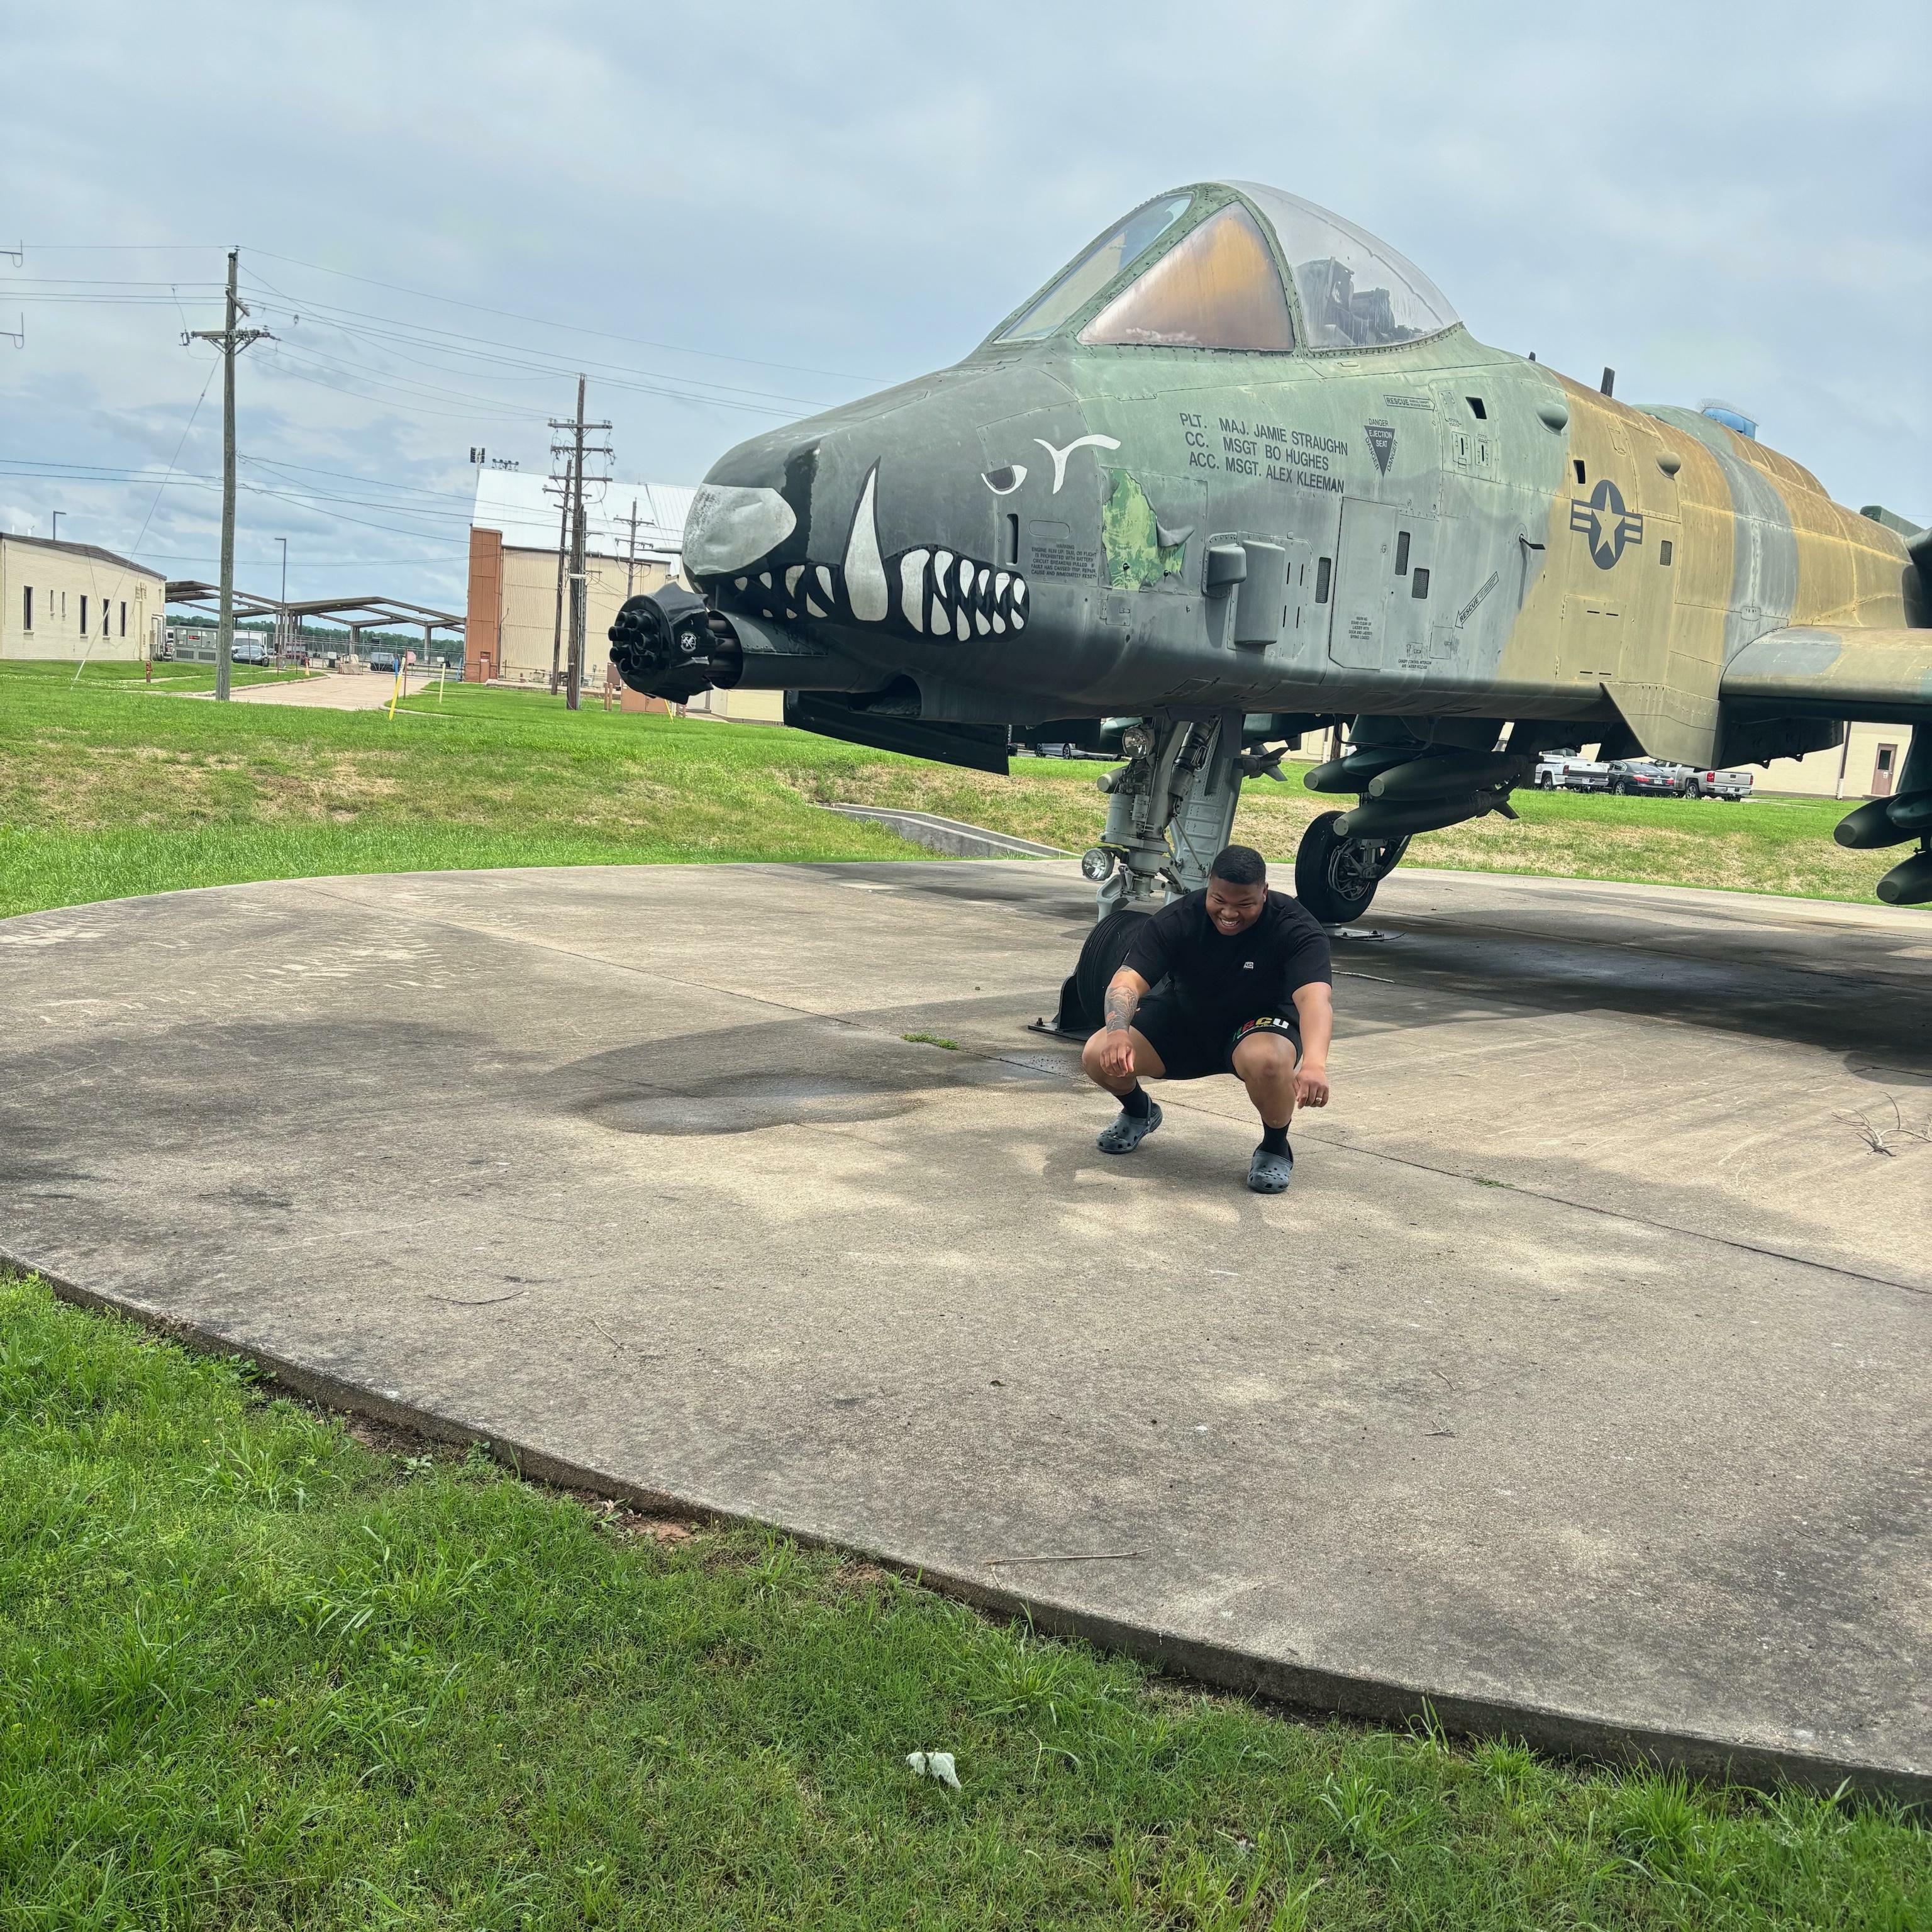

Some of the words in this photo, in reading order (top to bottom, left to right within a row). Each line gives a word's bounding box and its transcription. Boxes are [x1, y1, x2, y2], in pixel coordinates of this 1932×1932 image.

[1386, 397, 1409, 406] RESCUE
[1179, 413, 1207, 428] PLT.
[1219, 418, 1249, 435] MAJ.
[1254, 424, 1287, 443] JAMIE
[1292, 431, 1348, 456] STRAUGHN
[1368, 418, 1389, 426] DANGER
[1368, 430, 1392, 438] EJECTION
[1185, 431, 1209, 448] CC.
[1223, 436, 1257, 456] MSGT
[1265, 444, 1281, 460] BO
[1286, 448, 1329, 471] HUGHES
[1365, 436, 1379, 470] DANGER
[1387, 439, 1398, 472] DANGER
[1189, 452, 1219, 469] ACC.
[1226, 457, 1262, 477] MSGT.
[1266, 464, 1292, 483] ALEX
[1297, 471, 1344, 494] KLEEMAN
[1459, 597, 1479, 623] RESCUE
